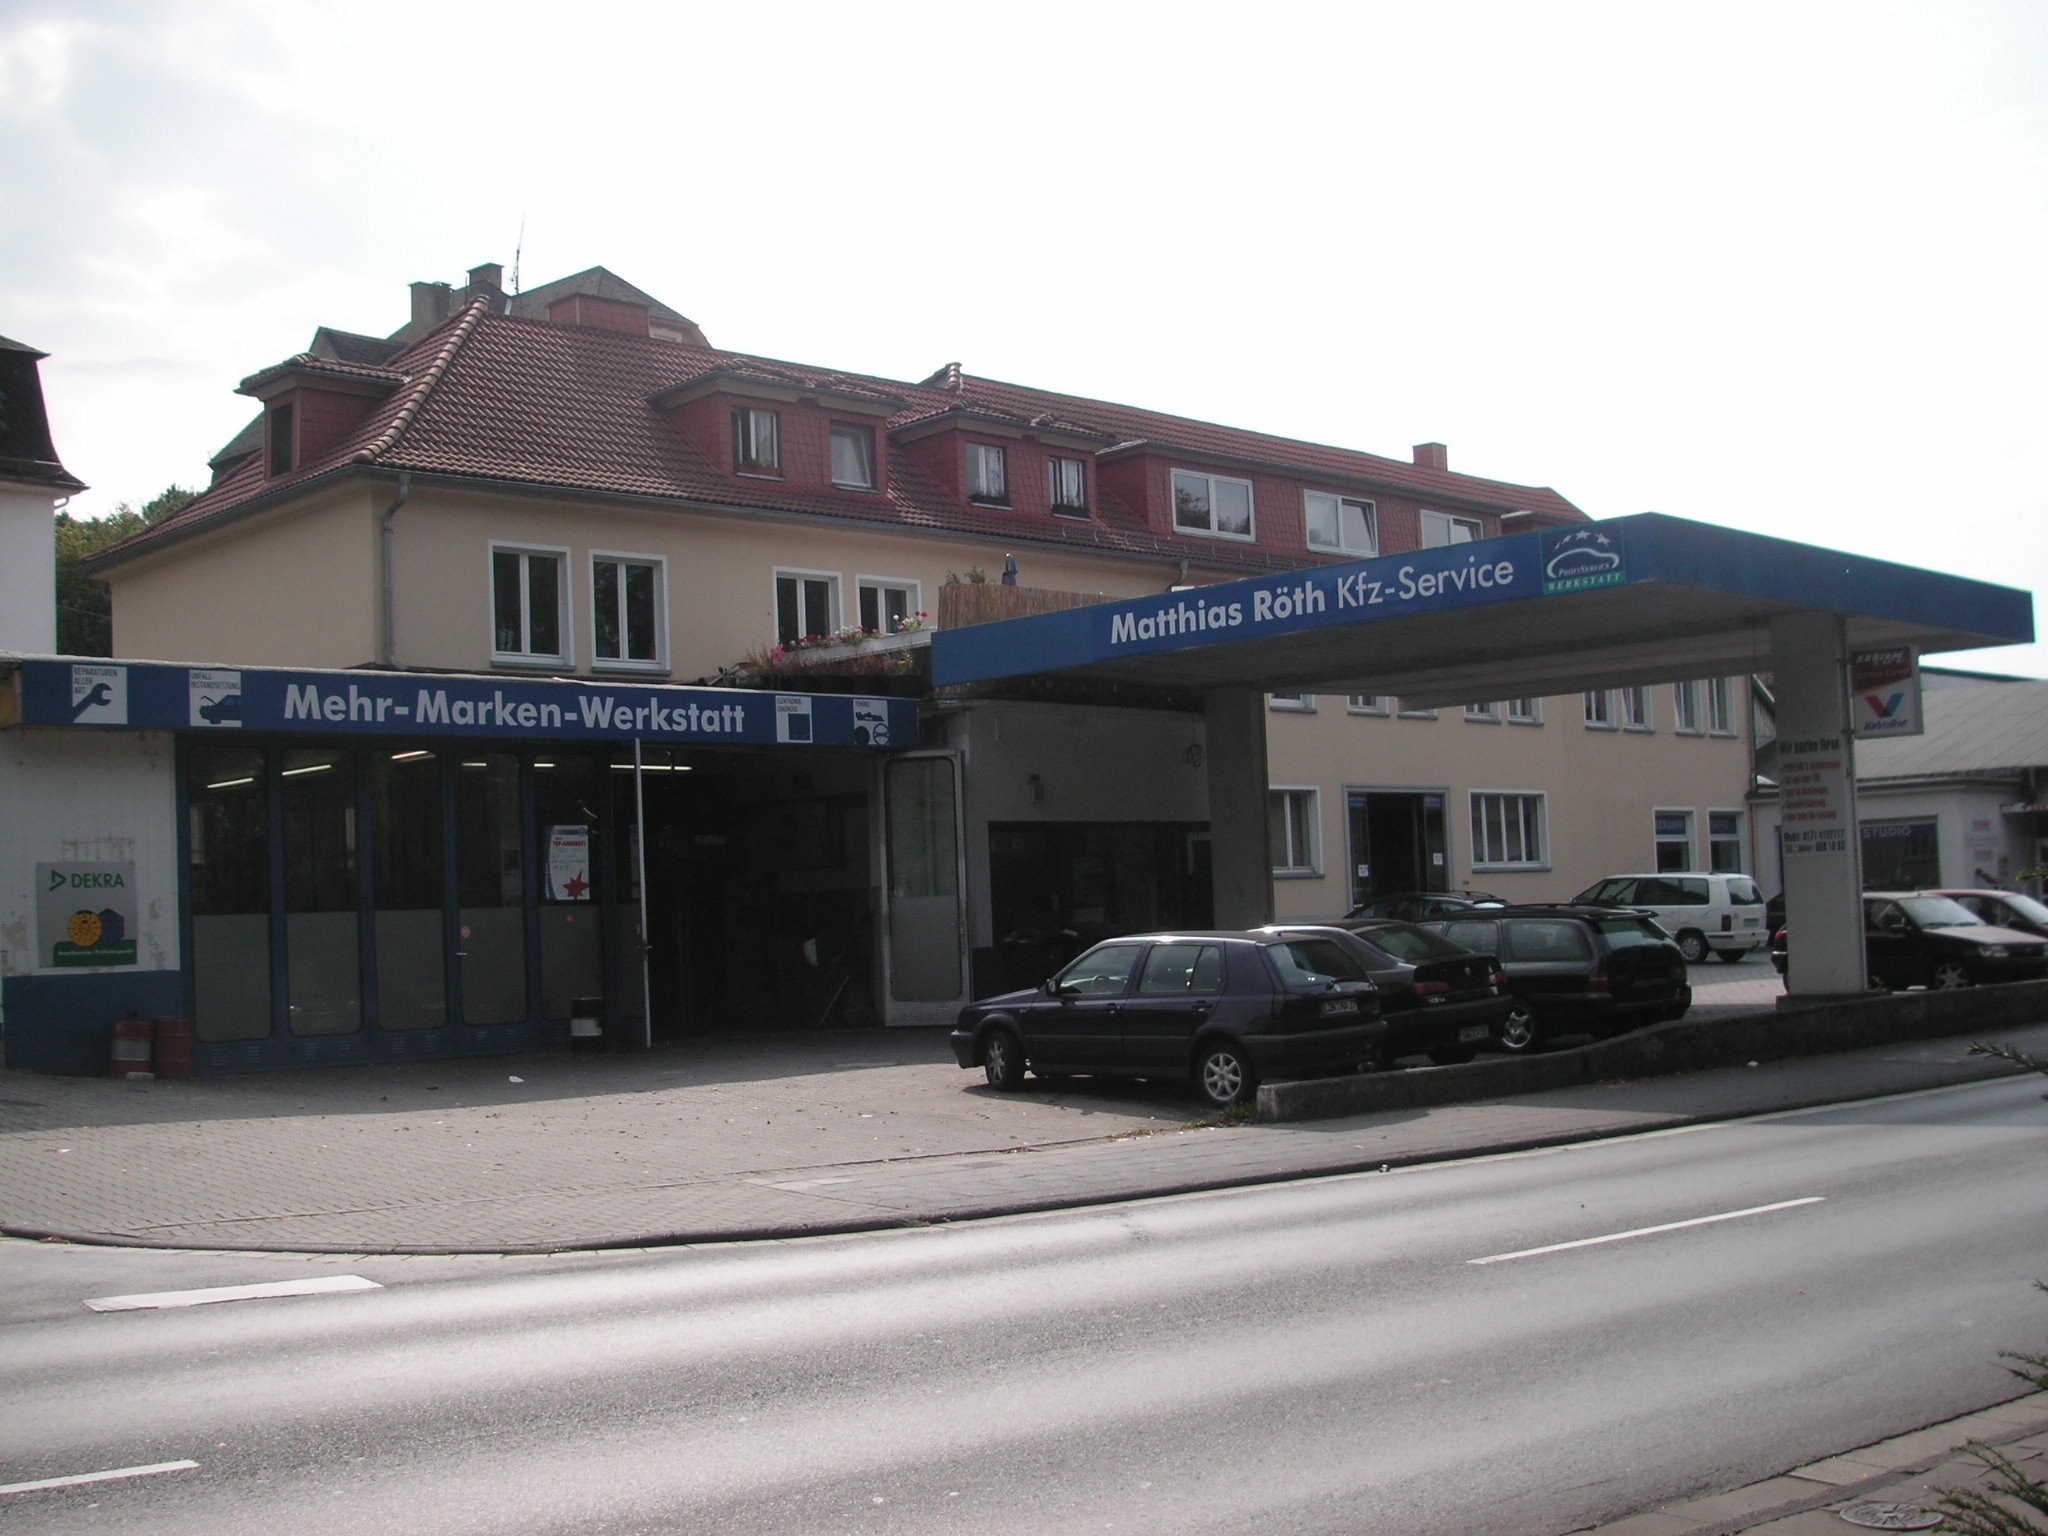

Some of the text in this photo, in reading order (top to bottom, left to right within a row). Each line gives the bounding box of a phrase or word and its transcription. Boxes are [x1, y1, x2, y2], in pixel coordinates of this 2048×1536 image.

[1547, 572, 1621, 591] WERKSTATT
[1111, 555, 1515, 645] Matthias Röth Kfz-Service
[74, 667, 118, 678] REPARATUREN
[284, 683, 745, 733] Mehr-Marken-Werkstatt
[1862, 825, 1912, 839] STUDIO
[71, 872, 125, 889] DEKRA
